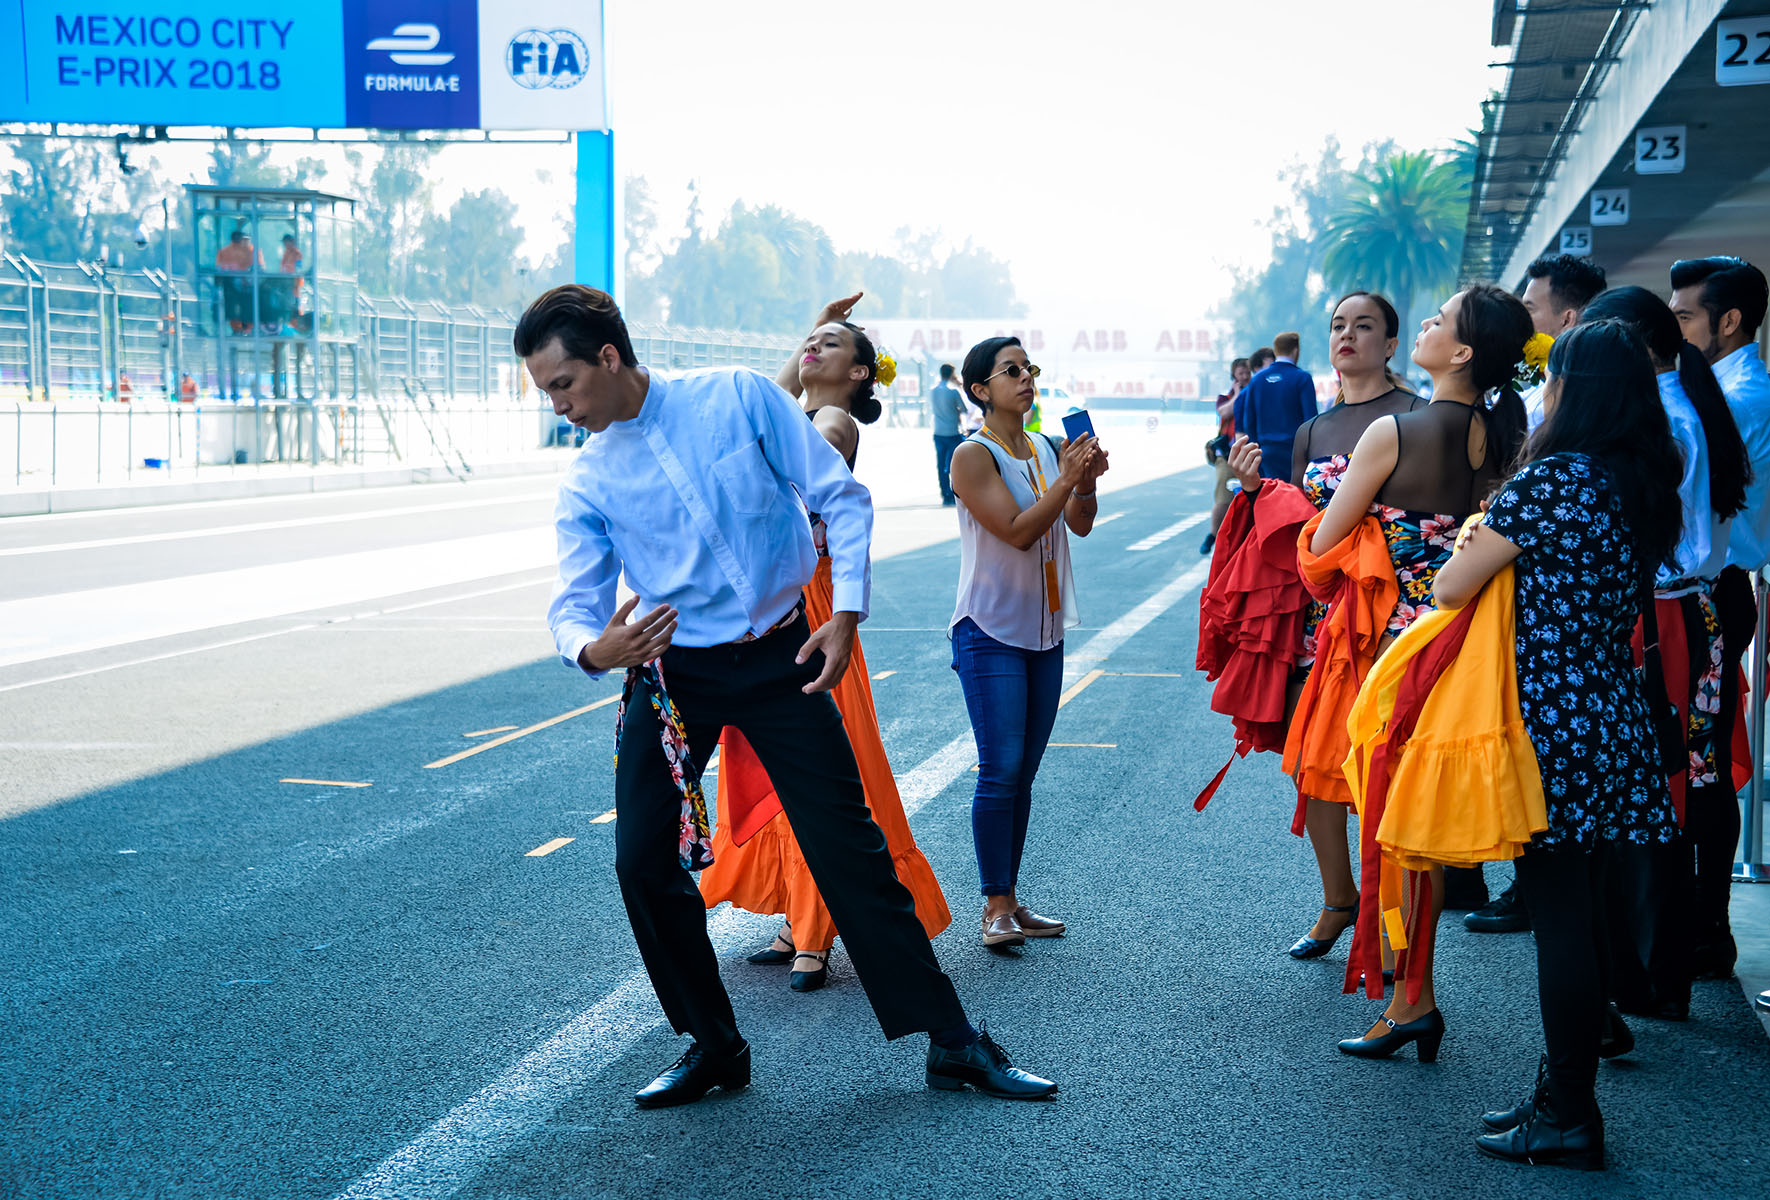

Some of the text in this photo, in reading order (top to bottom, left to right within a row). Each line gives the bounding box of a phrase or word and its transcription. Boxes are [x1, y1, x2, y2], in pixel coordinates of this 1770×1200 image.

[55, 14, 294, 50] MEXICO CITY
[1722, 31, 1770, 68] 22
[57, 56, 281, 91] E-PRIX 2018
[1639, 136, 1681, 162] 23
[1593, 196, 1626, 216] 24
[1563, 232, 1588, 249] 25
[907, 329, 963, 352] ABB
[1072, 329, 1128, 353] ABB
[1155, 329, 1212, 353] ABB
[1113, 381, 1145, 394] ABB
[1162, 381, 1194, 395] ABB
